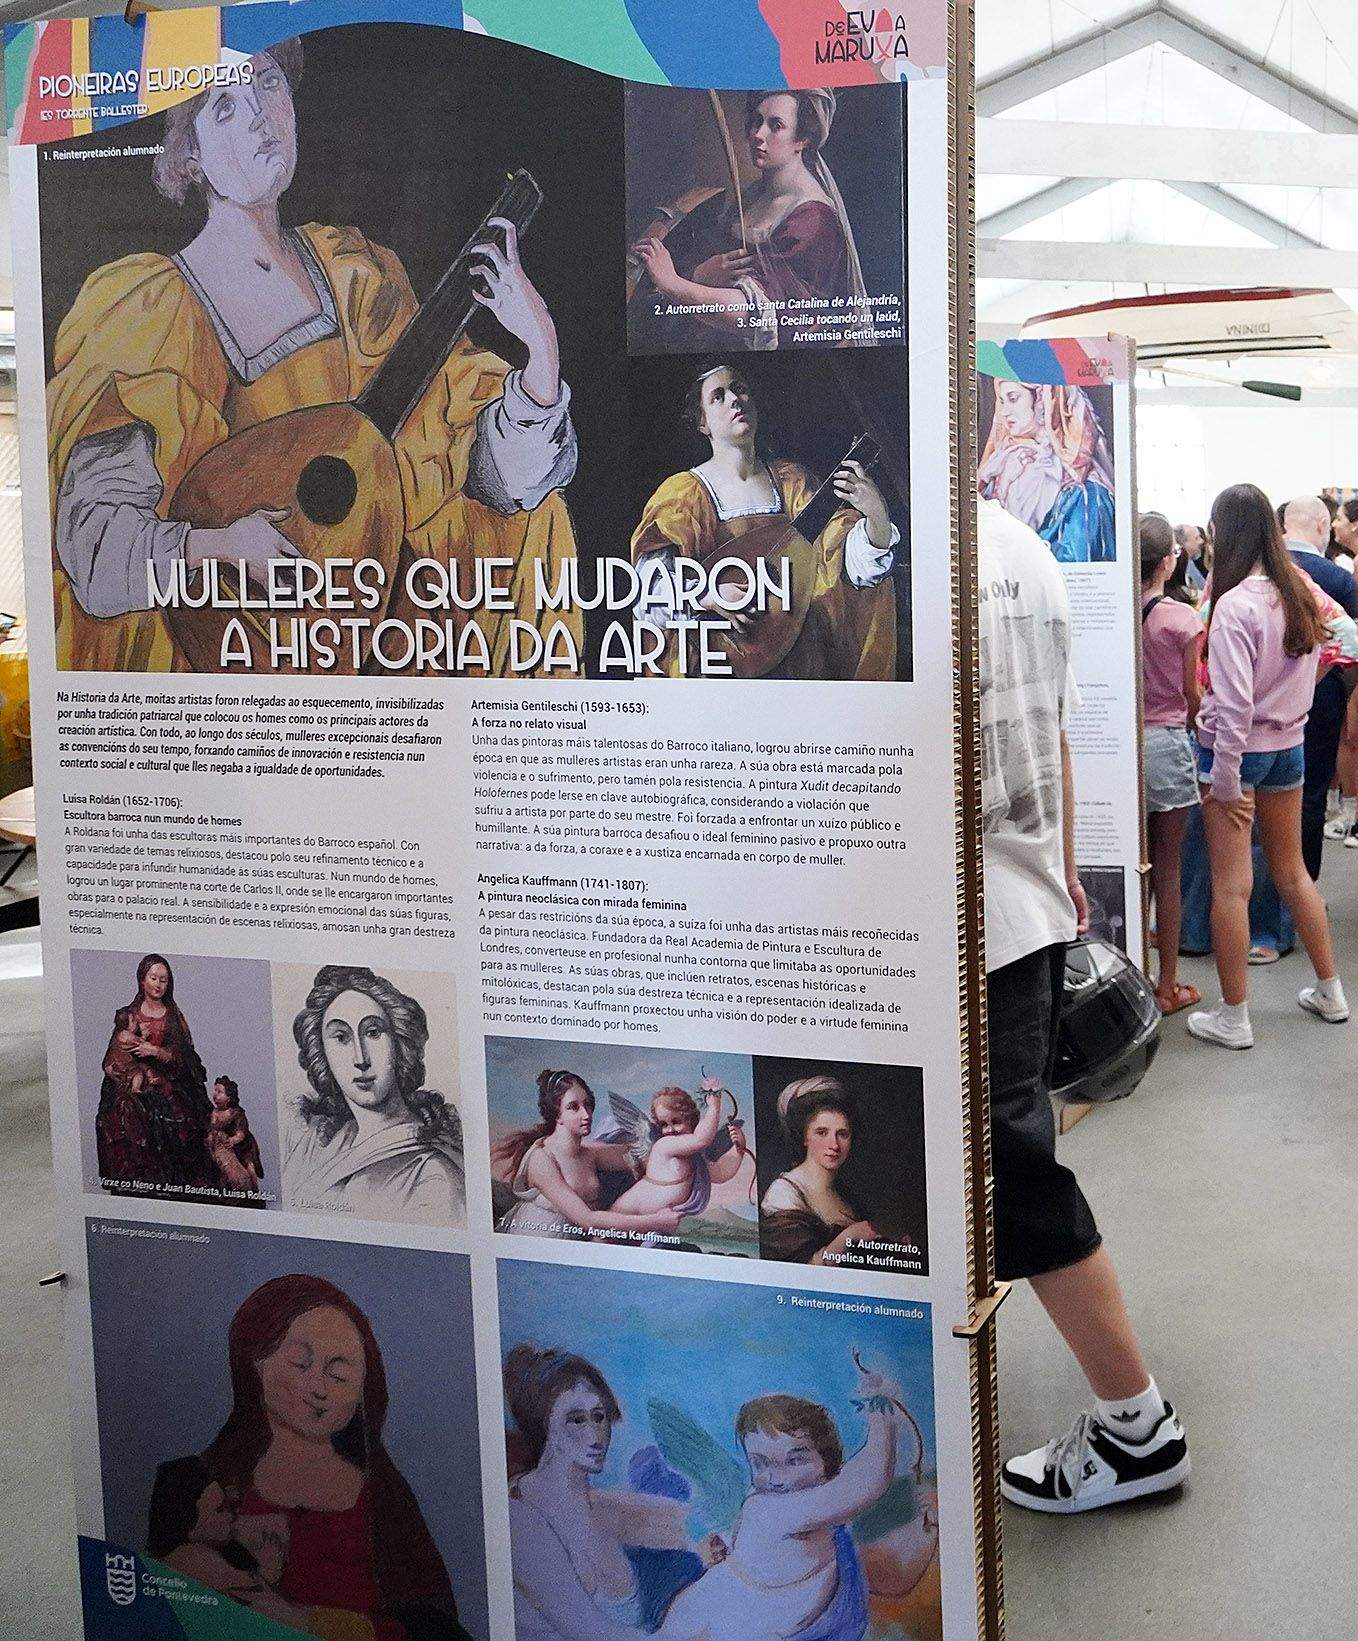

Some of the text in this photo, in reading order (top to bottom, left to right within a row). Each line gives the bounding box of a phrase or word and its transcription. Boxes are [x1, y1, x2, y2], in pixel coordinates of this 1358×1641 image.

[39, 62, 254, 98] PIONEIRAS EUROPEAS
[56, 108, 99, 119] TORRENTE
[101, 104, 148, 117] BALLESTER
[43, 145, 164, 162] 1. Reinterpretación alumnado
[654, 304, 664, 315] 2.
[666, 303, 725, 315] Autorretrato
[727, 302, 755, 312] como
[758, 300, 785, 311] santa
[788, 298, 829, 310] Catalina
[832, 297, 844, 308] de
[737, 310, 901, 328] 3. Santa Cecilia tocando un laúd,
[793, 328, 901, 342] Artemisia Gentileschi
[147, 557, 790, 612] MULLERES QUE MUDARON
[220, 618, 732, 674] A HISTORIA DA ARTE
[56, 691, 444, 710] Na Historia da Arte, moitas artistas foron relegadas ao esquecemento, invisibilizadas
[471, 700, 649, 715] Artemisia Gentileschi (1593-1653):
[472, 716, 587, 730] A forza no relato visual
[472, 734, 498, 745] Unha
[500, 735, 519, 746] das
[522, 736, 563, 748] pintoras
[594, 738, 648, 749] talentosas
[650, 739, 664, 750] do
[667, 740, 708, 751] Barroco
[711, 741, 753, 753] italiano,
[756, 742, 790, 756] logrou
[793, 742, 831, 755] abrirse
[834, 744, 876, 756] camiño
[879, 745, 914, 757] nunha
[63, 793, 183, 809] Luisa Roldán (1652-1706):
[64, 810, 242, 826] Escultora barroca nun mundo de homes
[64, 826, 71, 836] A
[73, 826, 110, 837] Roldana
[112, 827, 124, 838] foi
[126, 829, 149, 839] unha
[151, 830, 168, 840] das
[169, 831, 218, 842] escultoras
[244, 833, 301, 846] importantes
[303, 836, 316, 846] do
[318, 836, 355, 848] Barroco
[358, 839, 398, 851] español.
[400, 840, 420, 850] Con
[477, 873, 648, 893] Angelica Kauffmann (1741-1807):
[478, 890, 687, 911] A pintura neoclásica con mirada feminina
[478, 908, 486, 917] A
[488, 910, 516, 920] pesar
[518, 910, 537, 920] das
[595, 914, 608, 924] da
[632, 916, 666, 928] época,
[669, 920, 675, 928] a
[709, 919, 722, 930] foi
[726, 921, 752, 932] unha
[755, 922, 775, 934] das
[778, 924, 819, 936] artistas
[852, 928, 919, 942] recoñecidas
[162, 1183, 183, 1193] Juan
[184, 1184, 221, 1198] Bautista,
[169, 1231, 210, 1244] alumnado
[549, 1224, 560, 1232] de
[563, 1224, 586, 1237] Eros,
[588, 1227, 627, 1241] Angelica
[629, 1230, 680, 1244] Kauffmann
[846, 1238, 921, 1255] 8. Autorretrato,
[822, 1251, 921, 1270] Angelica Kauffmann
[776, 1295, 924, 1319] 9. Reinterpretación alumnado
